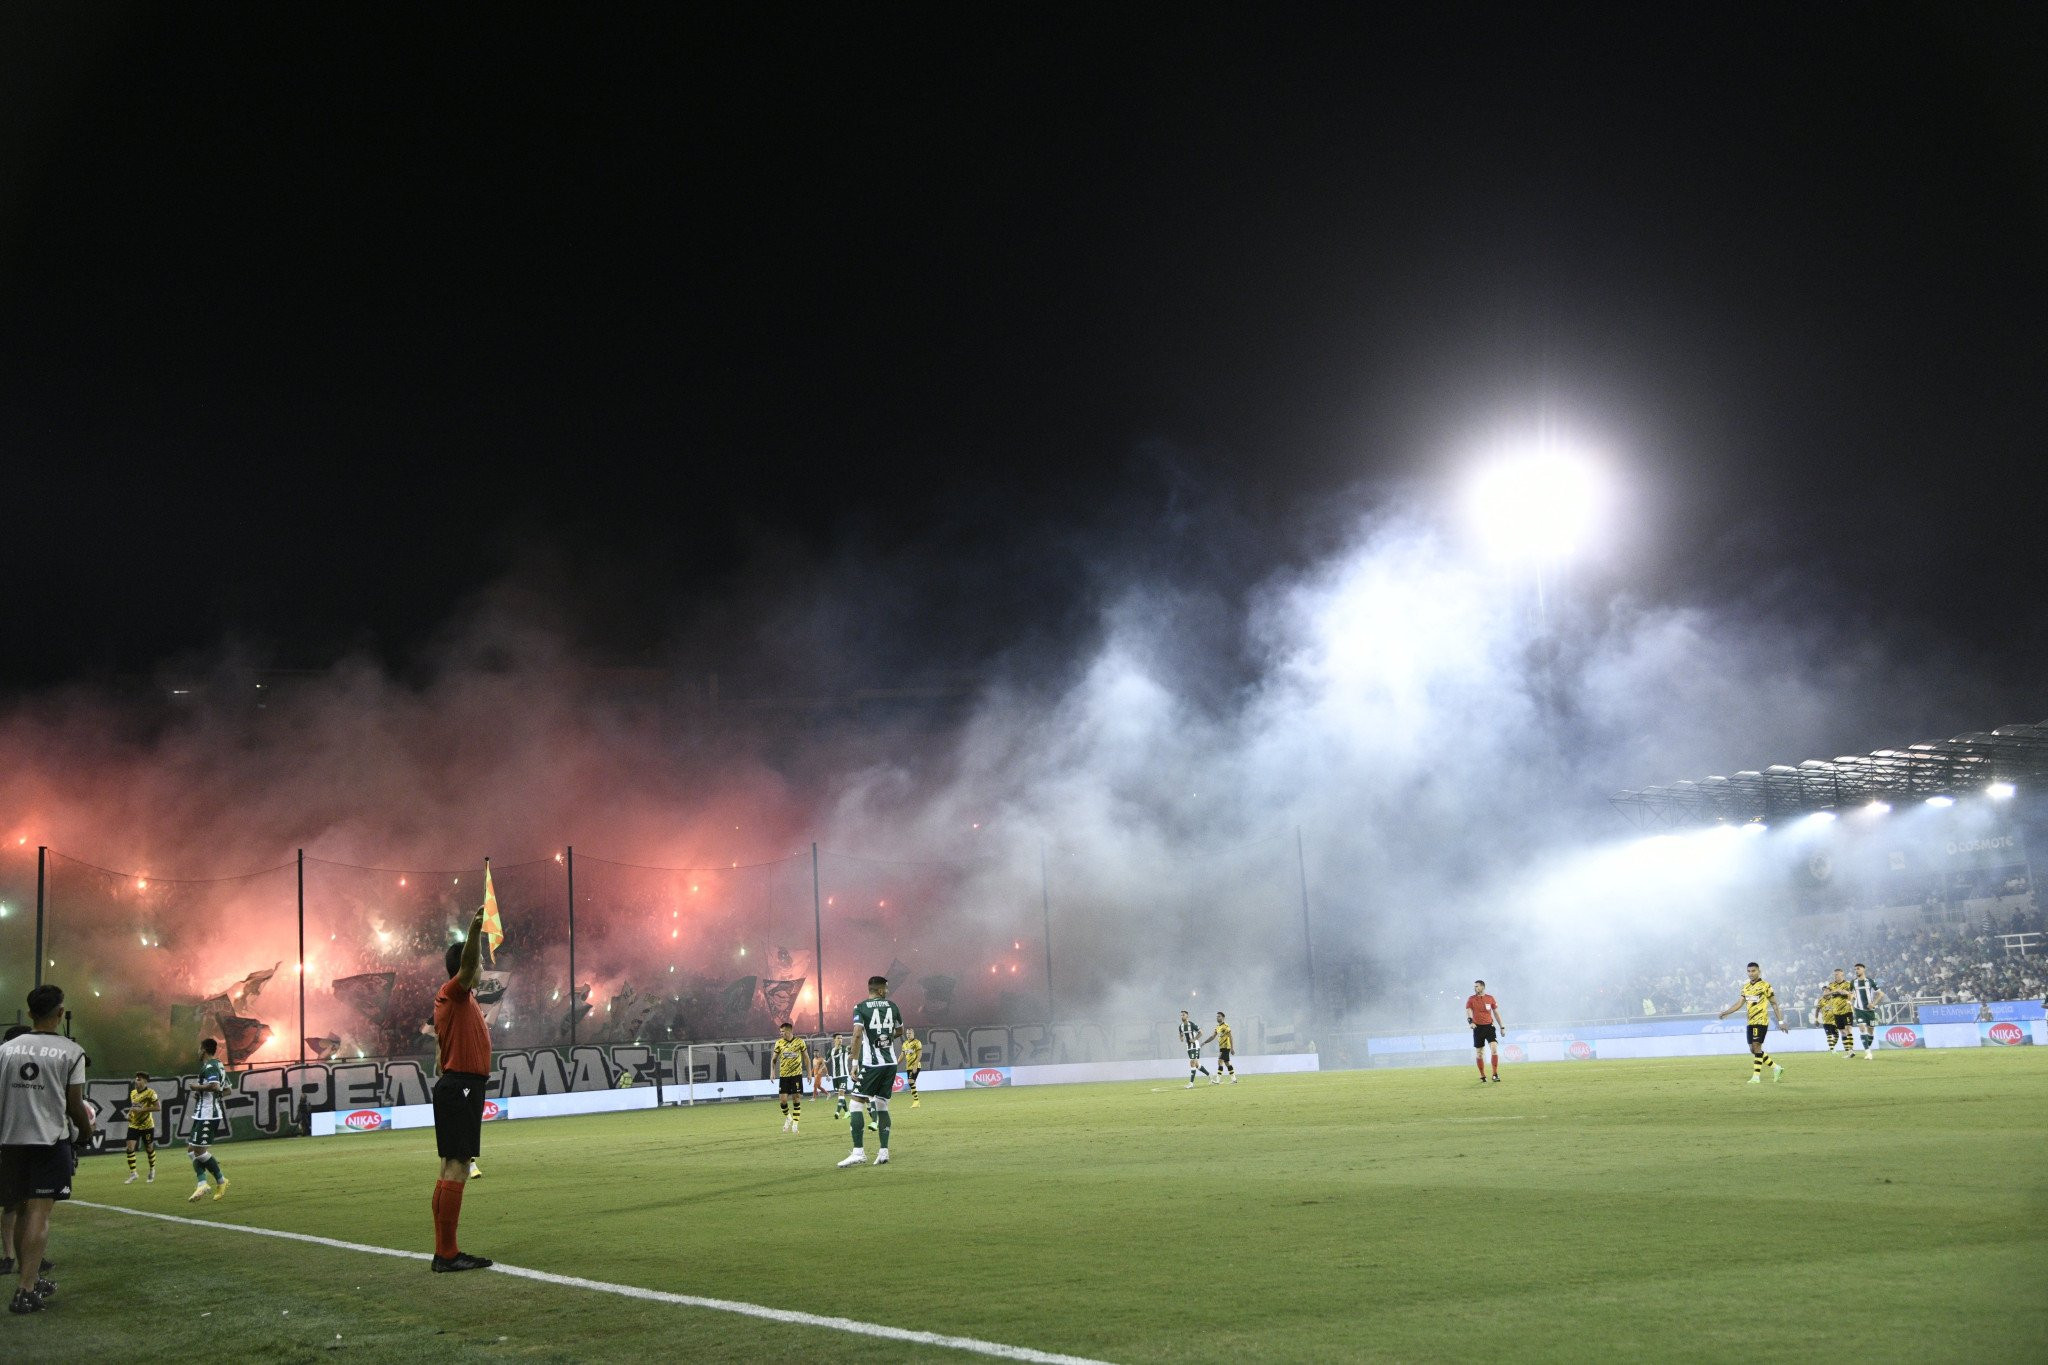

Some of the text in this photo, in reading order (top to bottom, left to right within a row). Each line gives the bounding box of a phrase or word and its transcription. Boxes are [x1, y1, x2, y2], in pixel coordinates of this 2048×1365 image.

[1958, 836, 2014, 853] COSMOTE
[869, 1007, 894, 1034] 44
[1887, 1029, 1915, 1043] NIKAS
[1991, 1028, 2021, 1039] NIKAS
[6, 1045, 67, 1060] BALL BOY
[975, 1073, 1001, 1082] NIKAS
[348, 1113, 381, 1127] NIKAS
